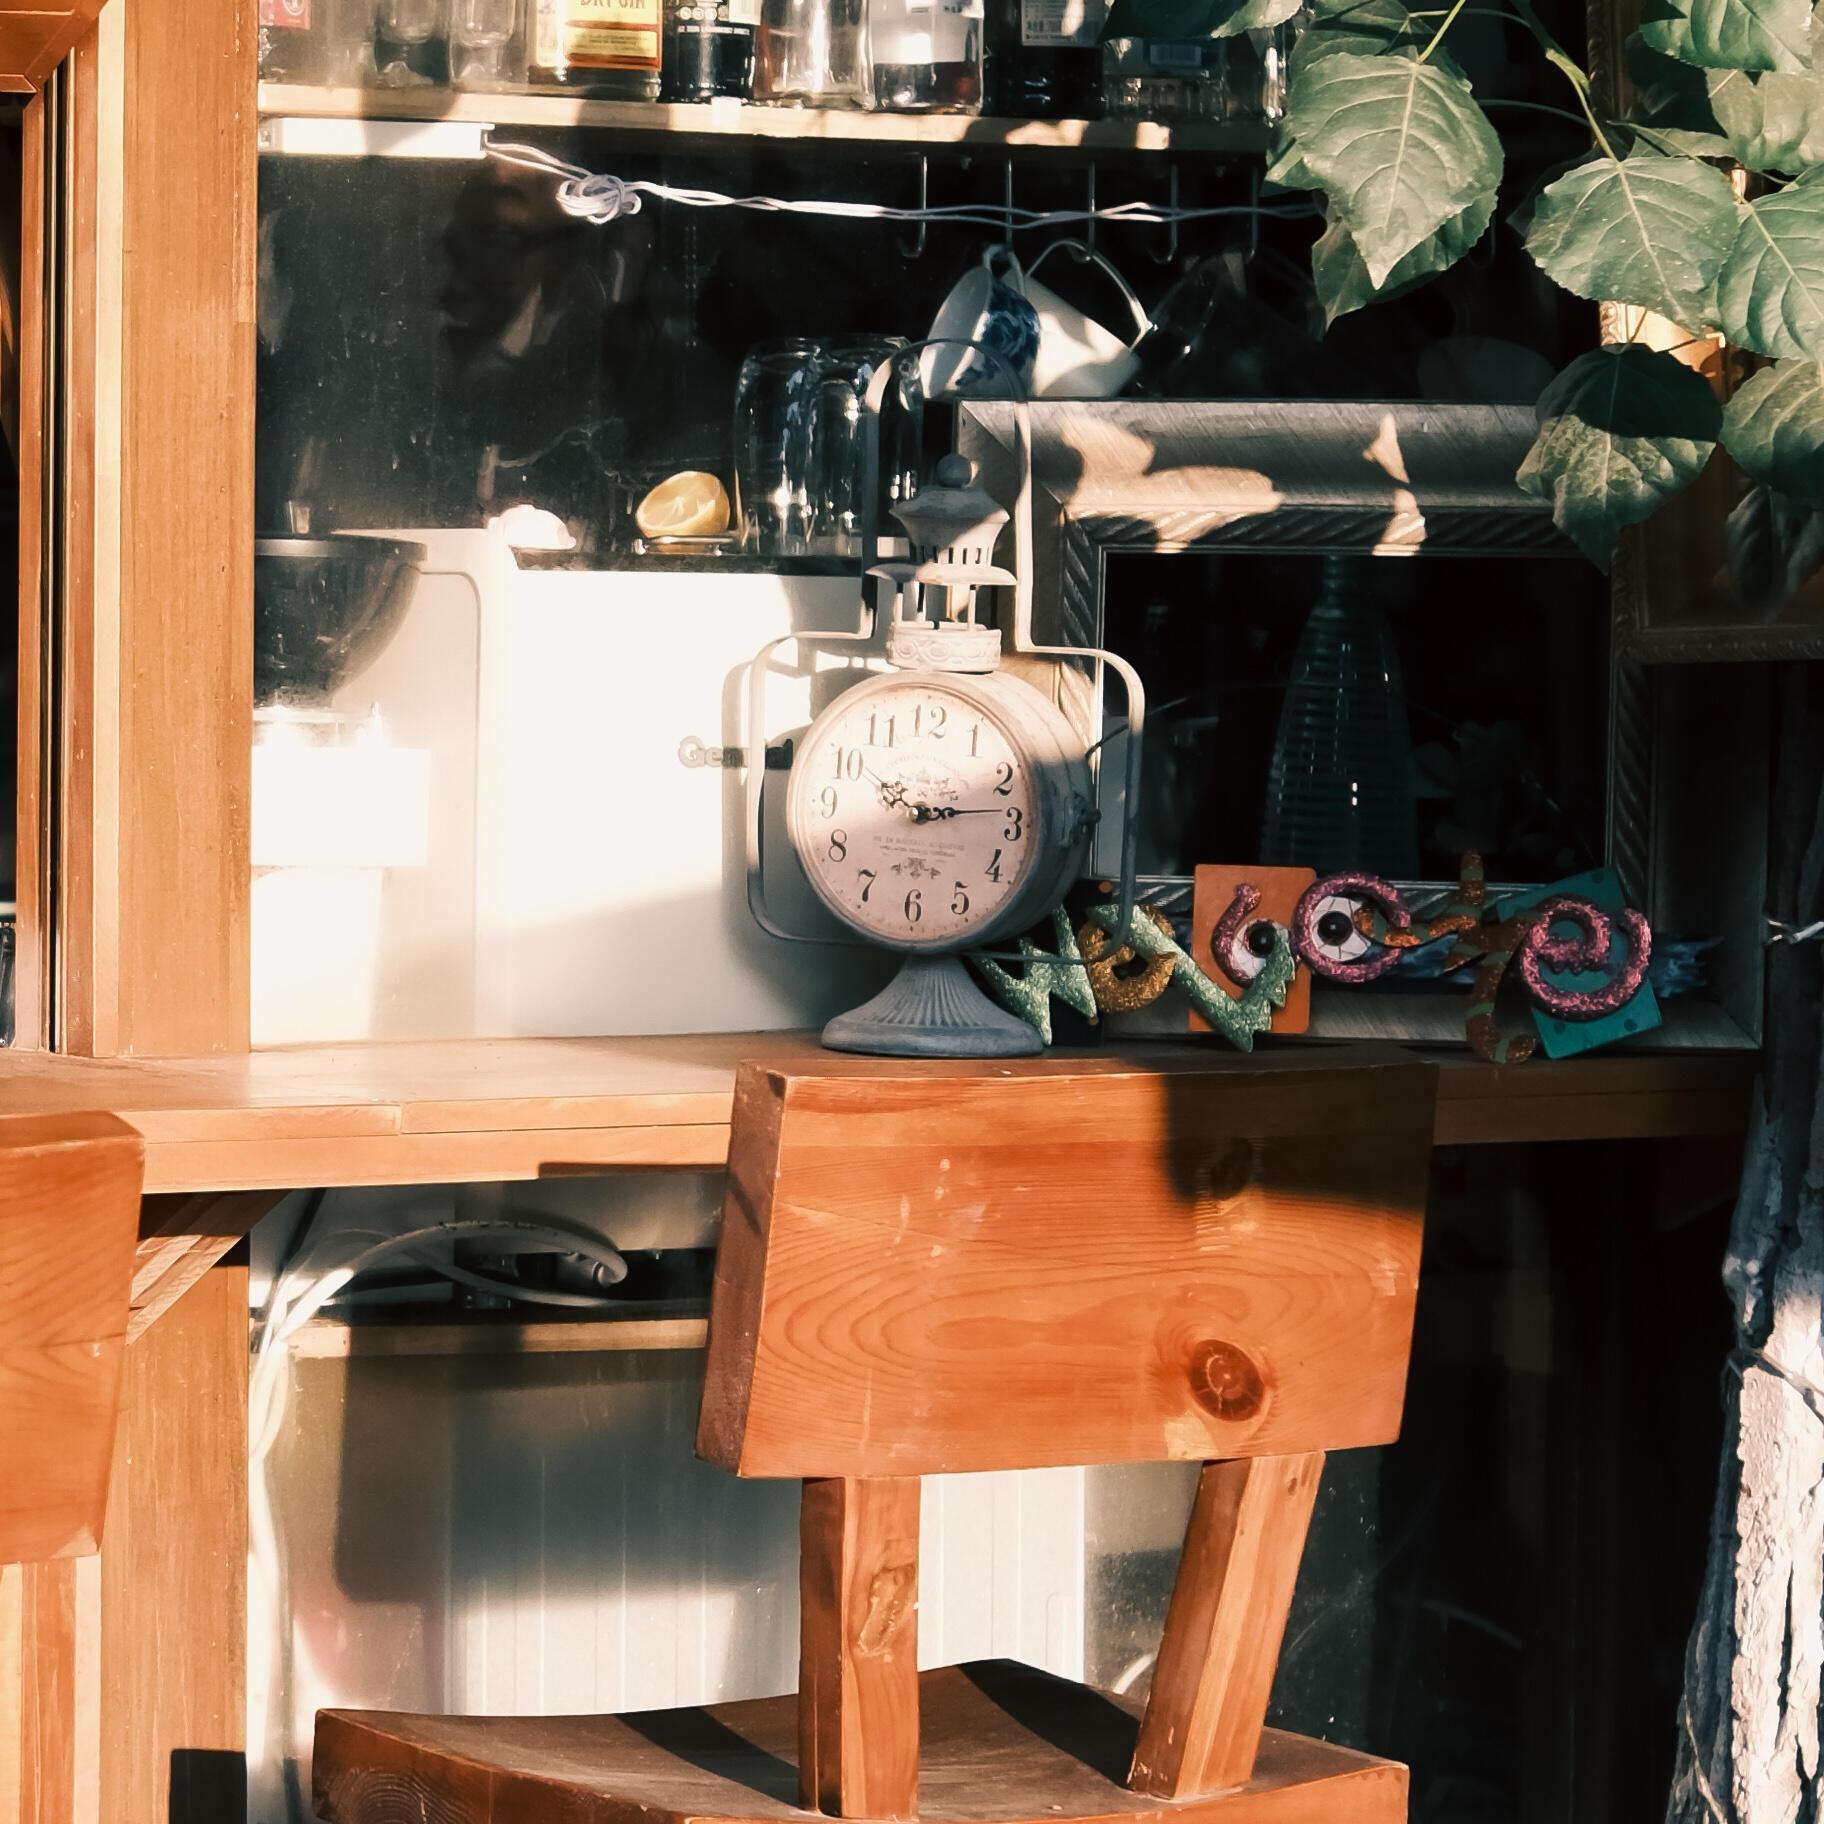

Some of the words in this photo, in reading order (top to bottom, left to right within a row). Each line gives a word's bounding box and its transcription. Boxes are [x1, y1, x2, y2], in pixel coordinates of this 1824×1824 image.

[864, 713, 896, 749] 11
[911, 704, 947, 739] 12
[964, 724, 983, 758] 1
[833, 746, 864, 781] 10
[993, 762, 1014, 796] 2
[821, 785, 837, 819] 9
[1004, 806, 1023, 841] 3
[828, 829, 847, 863] 8
[984, 848, 1004, 883] 4
[857, 868, 877, 902] 7
[951, 881, 969, 915] 5
[904, 888, 922, 922] 6
